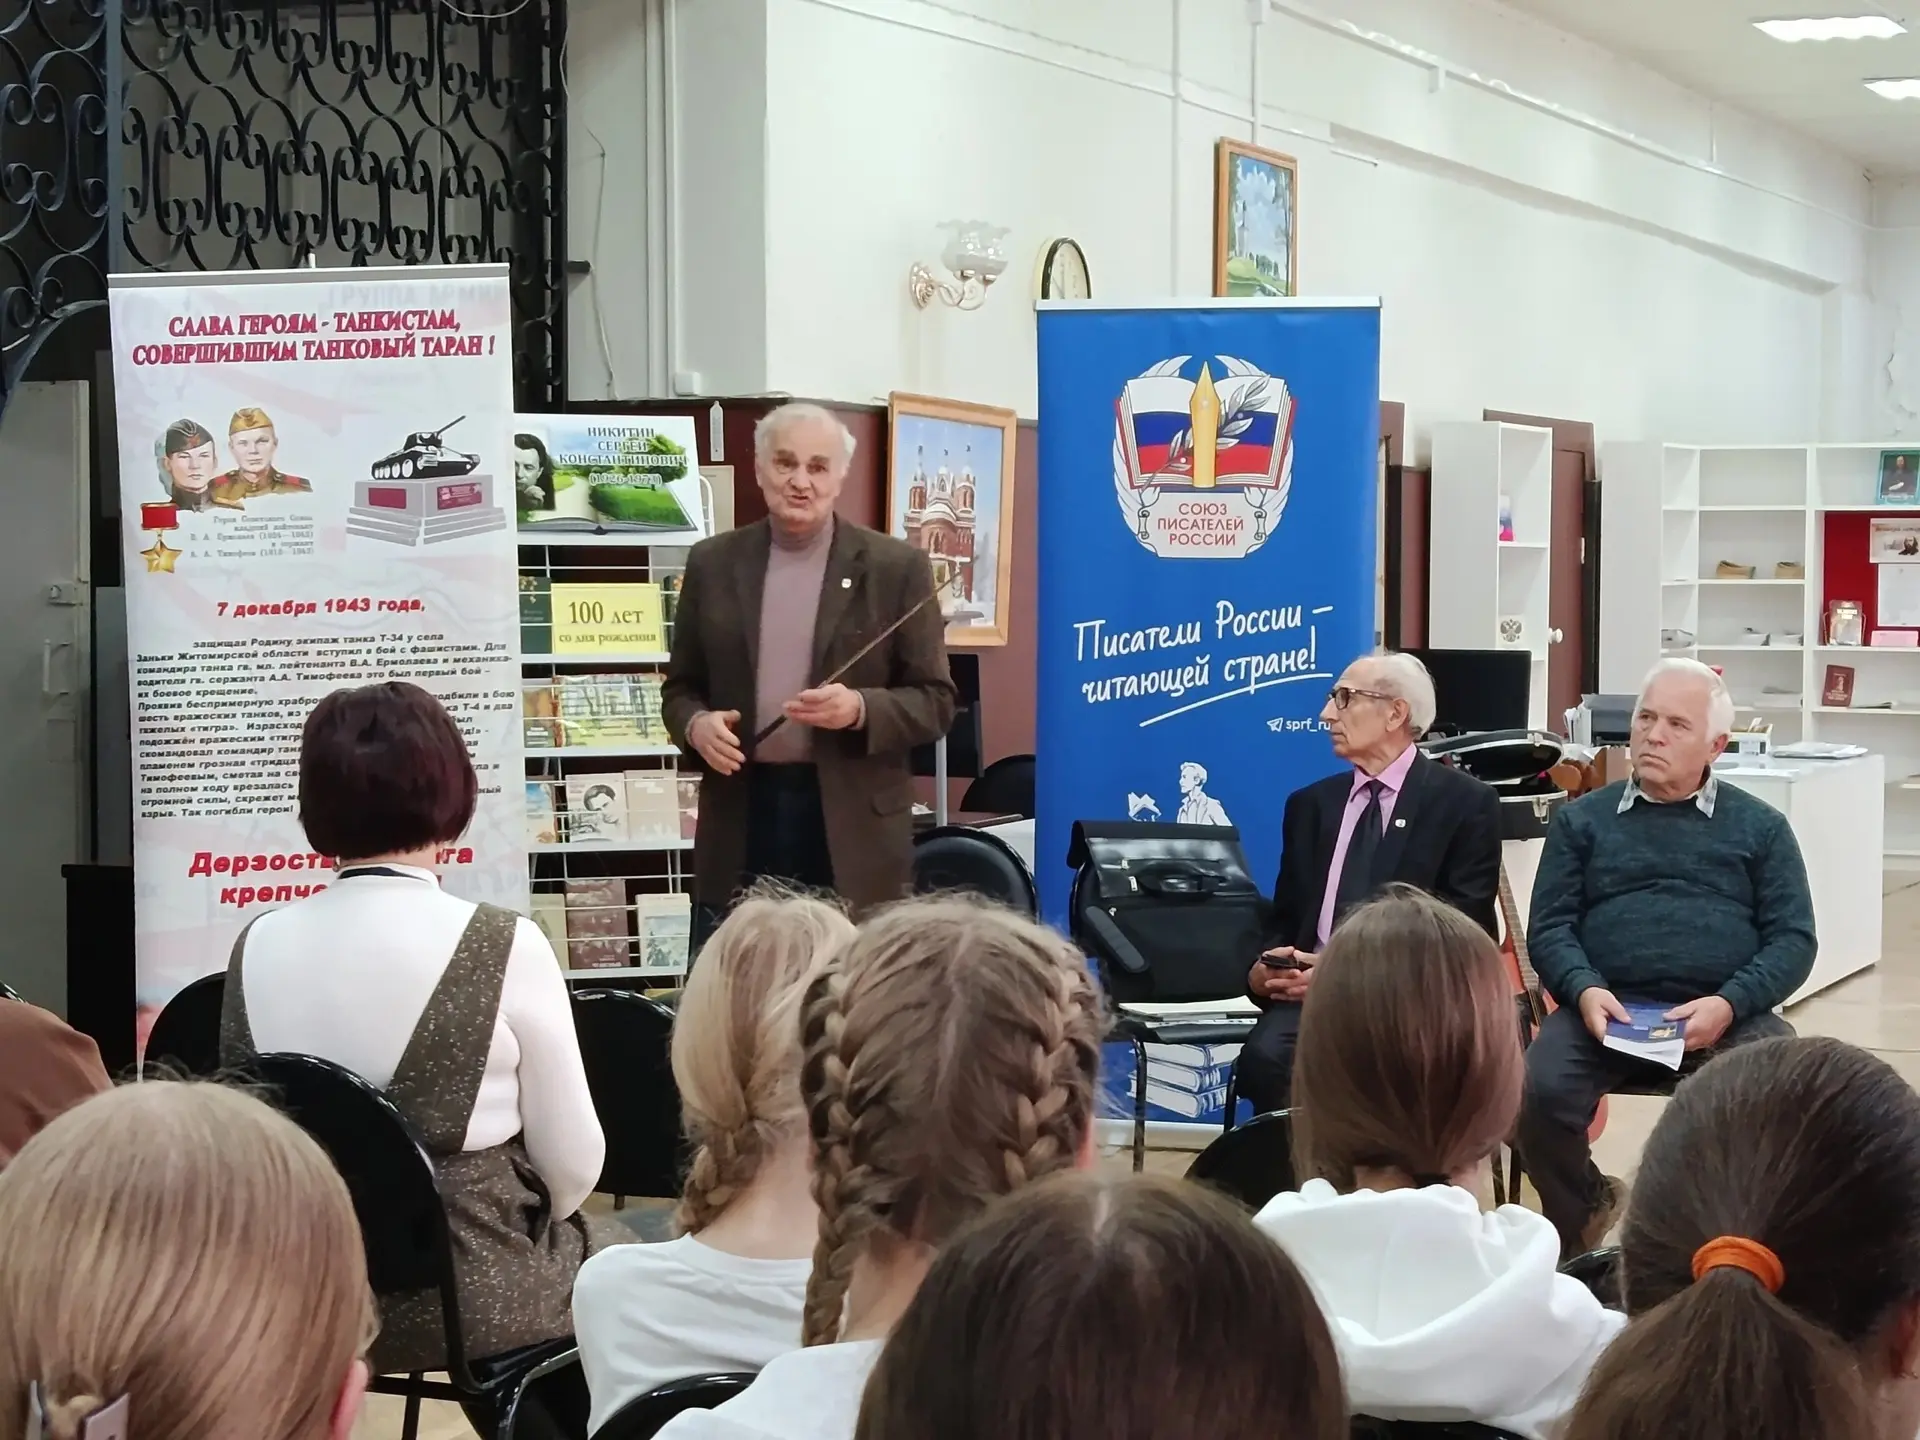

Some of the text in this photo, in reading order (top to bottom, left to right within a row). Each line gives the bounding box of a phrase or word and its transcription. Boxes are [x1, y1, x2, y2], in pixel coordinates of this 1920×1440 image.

[168, 314, 231, 337] СЛАВА
[238, 313, 317, 334] ГЕРОЯМ
[333, 308, 461, 333] ТАНКИСТАМ,
[132, 341, 298, 366] СОВЕРШИВШИМ
[302, 332, 415, 361] ТАНКОВЫЙ
[420, 336, 483, 357] ТАРАН
[588, 427, 655, 438] НИКИТИН
[597, 439, 649, 451] СЕРГЕЙ
[559, 454, 687, 465] КОНСТАНТИНОВИЧ
[1178, 503, 1227, 516] СОЮЗ
[1157, 516, 1244, 531] ПИСАТЕЛЕЙ
[1169, 533, 1236, 546] РОССИИ
[216, 597, 426, 618] 7 декабря 1943 года,
[569, 602, 644, 624] 100 лет
[1073, 619, 1200, 661] Писатели
[1216, 600, 1301, 639] России
[192, 639, 247, 649] защищая
[296, 636, 340, 646] экипаж
[380, 634, 403, 642] Т-34
[407, 635, 414, 644] у
[416, 633, 443, 641] села
[559, 632, 656, 645] со дня рождения
[177, 650, 258, 661] Житомирской
[262, 649, 309, 658] области
[316, 648, 362, 657] вступил
[376, 646, 396, 654] бой
[410, 644, 480, 655] фашистами.
[137, 665, 196, 675] командира
[200, 664, 233, 672] танка
[279, 660, 345, 670] лейтенанта
[376, 657, 438, 667] Ермолаева
[1081, 625, 1316, 703] читающей стране!
[137, 678, 186, 687] водителя
[209, 675, 265, 685] сержанта
[296, 671, 362, 682] Тимофеева
[388, 669, 411, 677] был
[414, 668, 457, 677] первый
[461, 666, 481, 675] бой
[153, 689, 192, 697] боевое
[195, 687, 258, 697] крещение.
[138, 702, 182, 711] Проявив
[187, 698, 274, 709] беспримерную
[493, 690, 515, 698] бою
[138, 715, 169, 723] шесть
[173, 712, 237, 722] вражеских
[241, 711, 283, 719] танков,
[463, 703, 480, 711] Т-4
[493, 703, 513, 711] два
[139, 726, 186, 734] тяжелых
[1285, 717, 1331, 732] sprf_ru
[200, 735, 265, 744] вражеским
[139, 749, 213, 758] скомандовал
[217, 747, 274, 756] командир
[140, 762, 195, 770] пламенем
[199, 760, 246, 769] грозная
[141, 774, 218, 783] Тимофеевым,
[156, 785, 199, 794] полном
[202, 784, 229, 793] ходу
[233, 782, 294, 791] врезалась
[141, 796, 193, 807] огромной
[197, 796, 231, 805] силы,
[235, 794, 284, 803] скрежет
[141, 805, 294, 818] взрыв. Так погибли герои!
